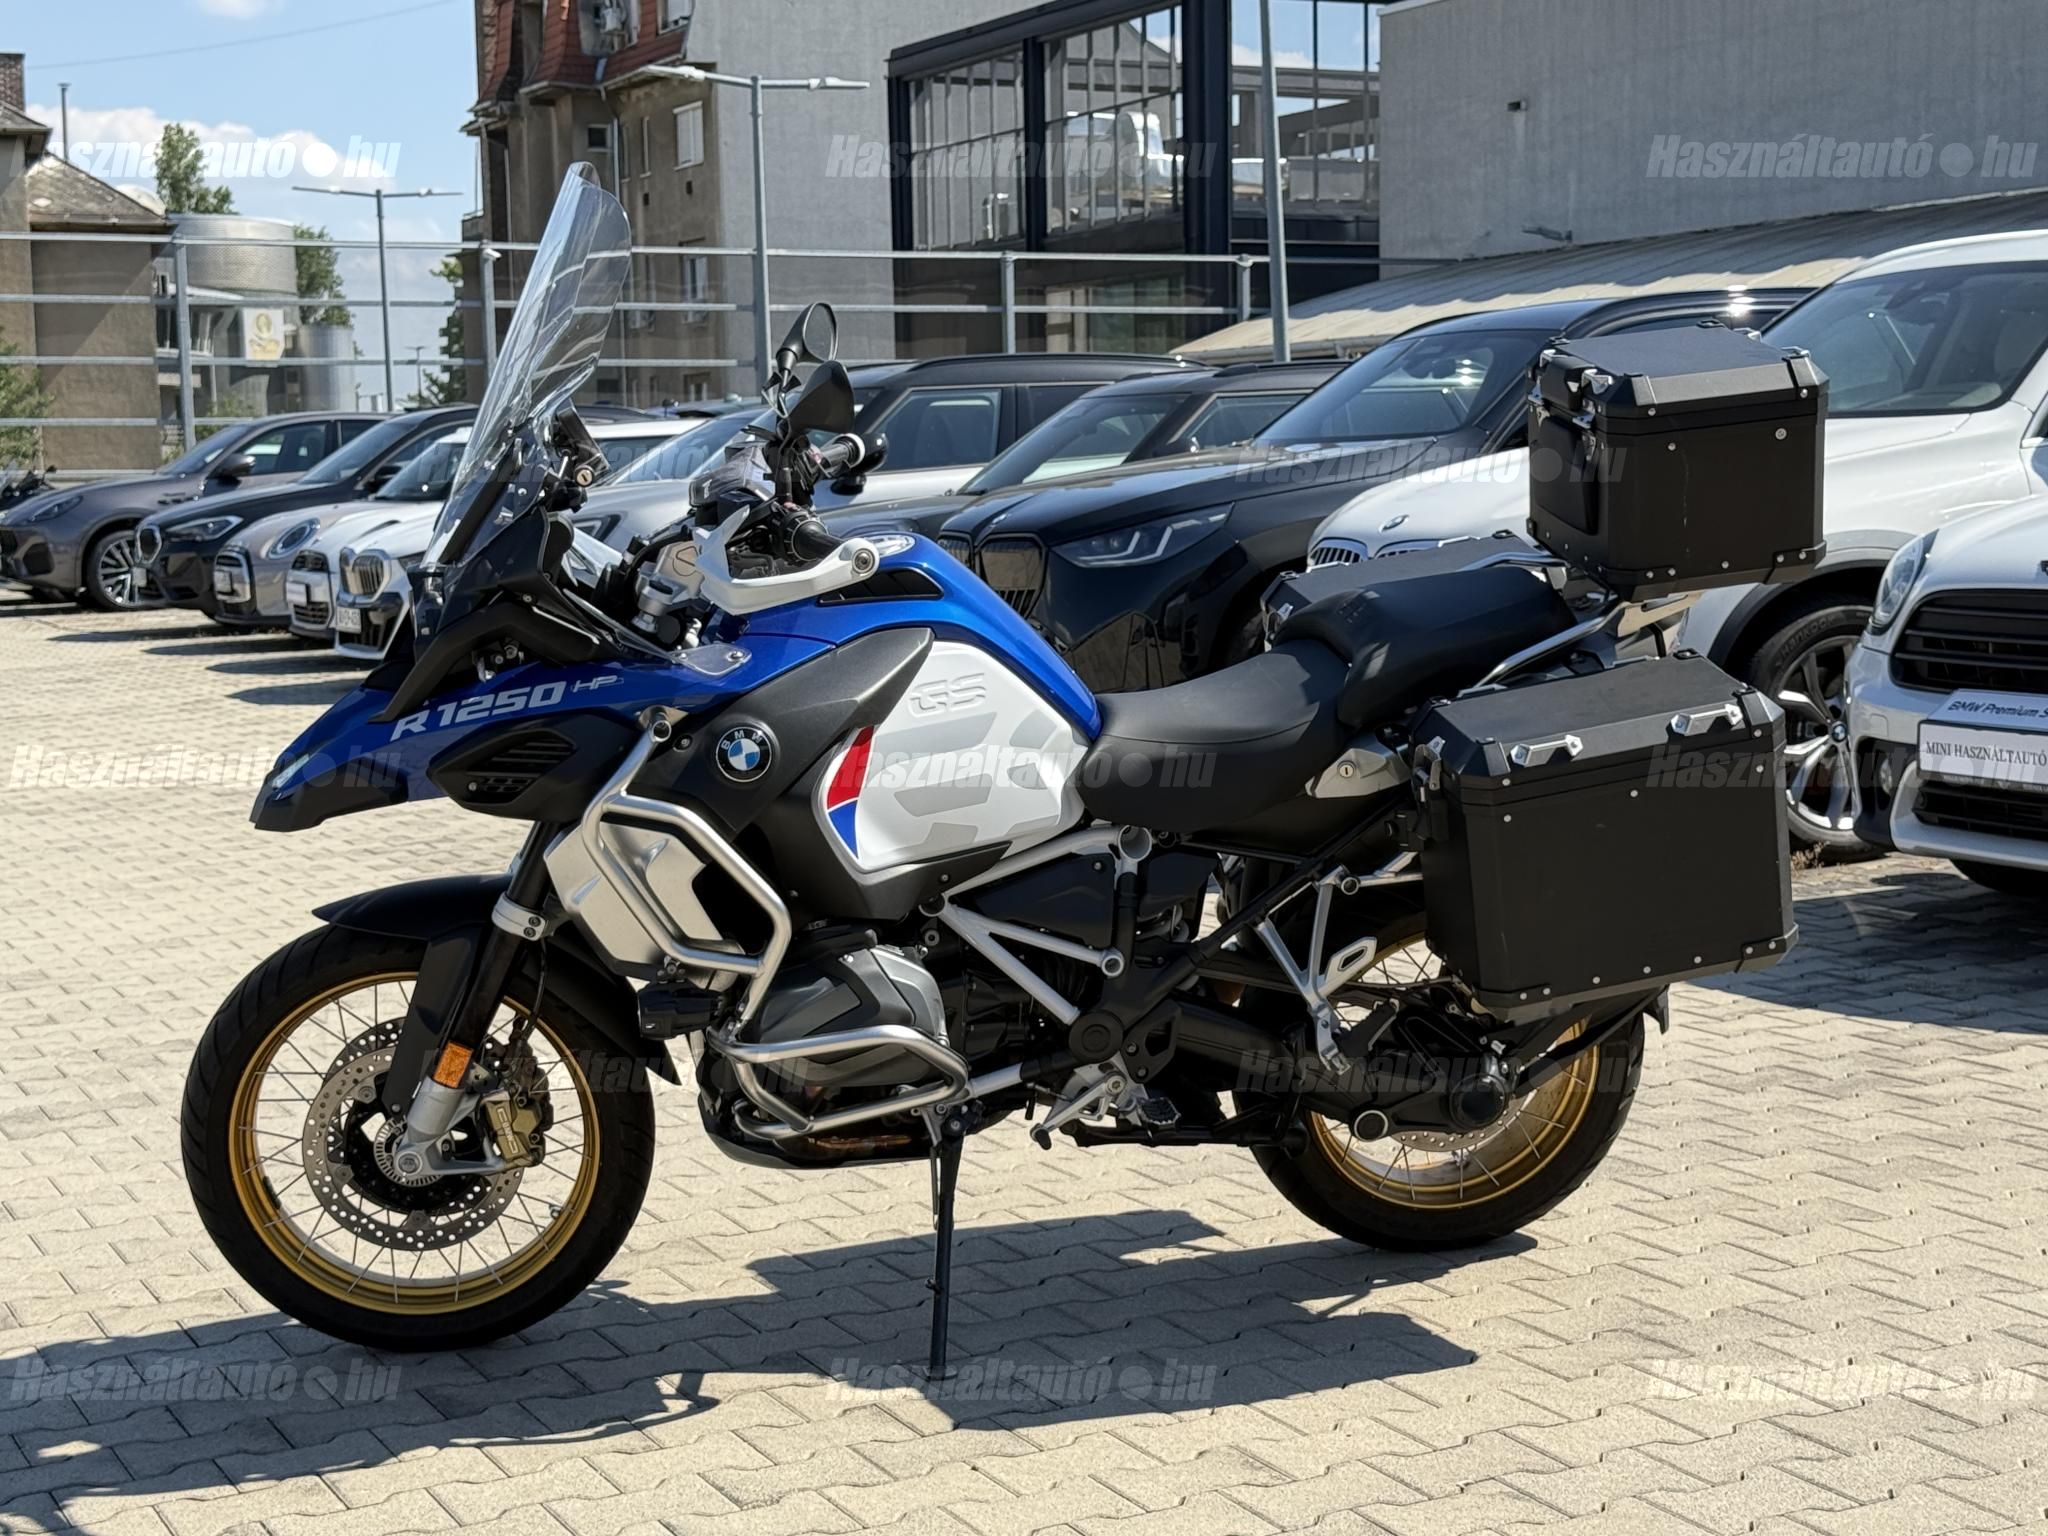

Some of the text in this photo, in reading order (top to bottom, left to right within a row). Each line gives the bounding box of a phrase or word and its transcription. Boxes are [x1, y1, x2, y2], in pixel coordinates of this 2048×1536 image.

[909, 672, 987, 717] GS
[389, 675, 624, 742] R 1250 HP
[1948, 701, 1983, 711] BMW
[1983, 702, 2037, 718] Premium
[721, 730, 763, 751] BMW
[1926, 741, 2047, 767] MINI HASZNÁLTAUTÓ
